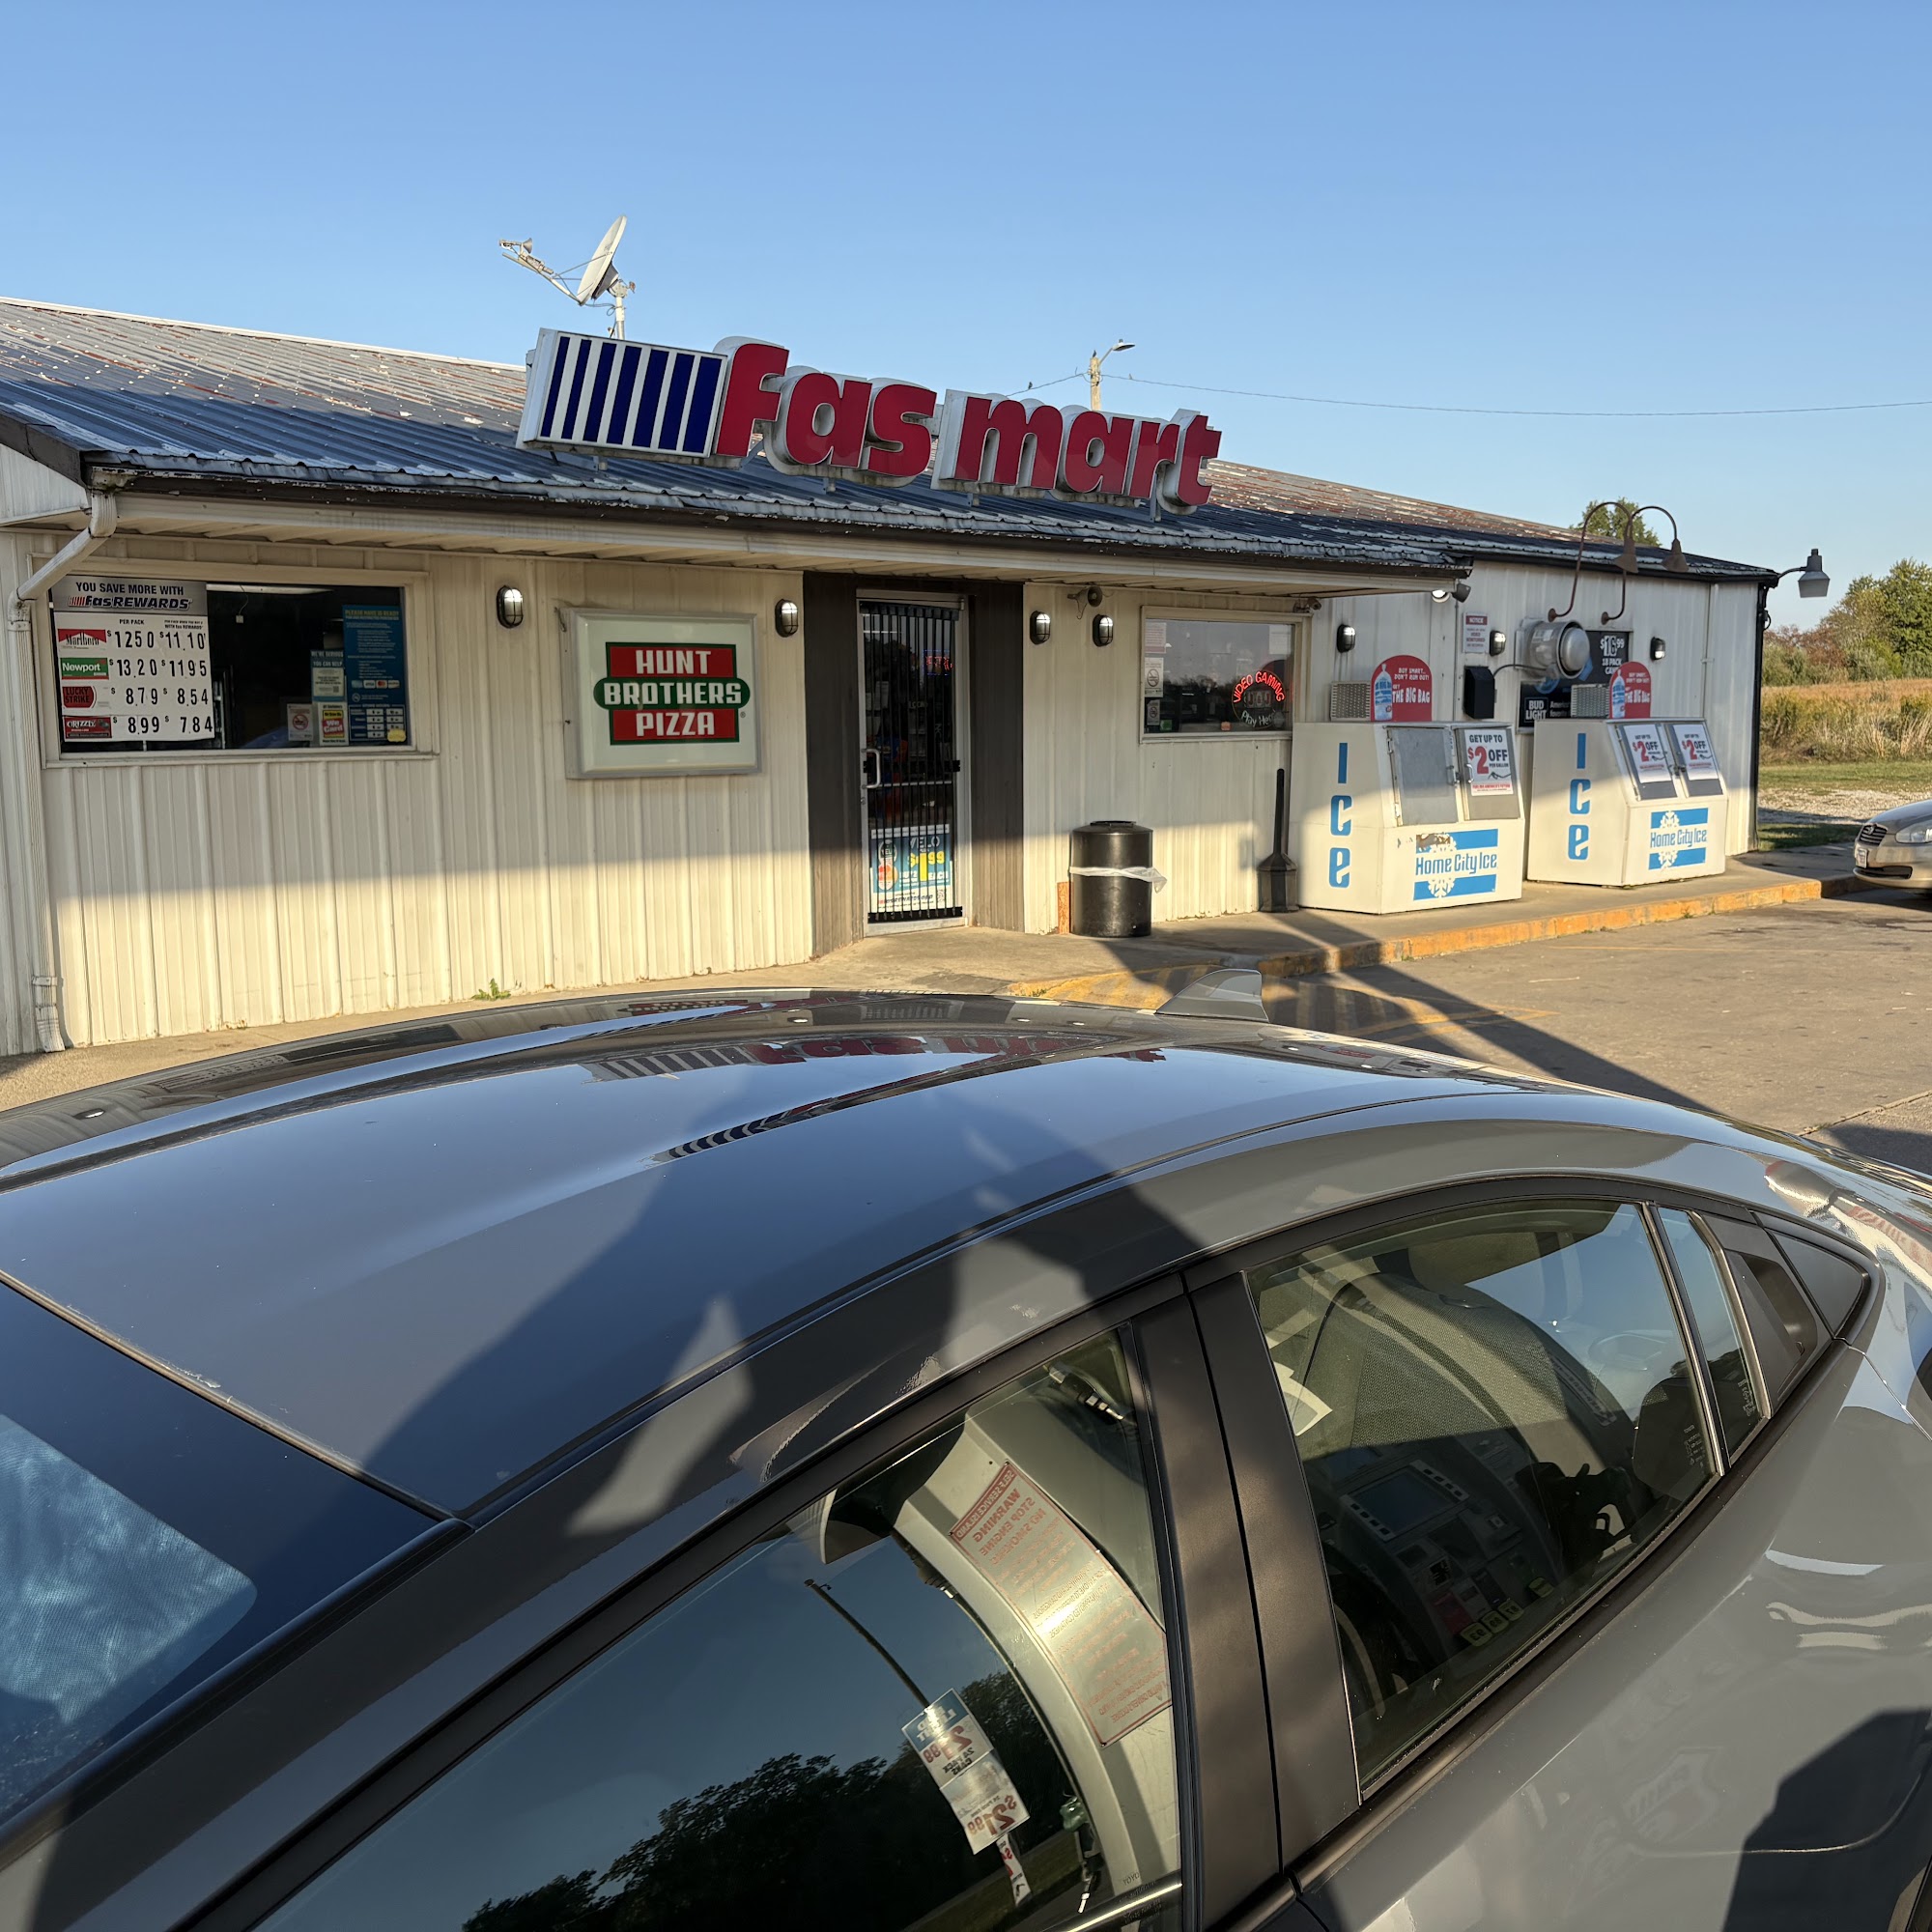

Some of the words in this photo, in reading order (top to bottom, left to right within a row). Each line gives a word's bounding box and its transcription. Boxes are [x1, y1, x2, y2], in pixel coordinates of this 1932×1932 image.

[955, 397, 1222, 506] mart
[76, 582, 97, 592] YOU
[99, 583, 126, 593] SAVE
[128, 584, 156, 594] MORE
[159, 585, 184, 596] WITH
[66, 632, 99, 646] Marlboro
[62, 662, 101, 673] Newport
[636, 650, 711, 674] HUNT
[604, 682, 741, 704] BROTHERS
[1234, 674, 1253, 703] VIDEO
[1256, 671, 1285, 701] GAMING
[1392, 689, 1404, 703] THE
[1406, 687, 1416, 703] BIG
[1417, 689, 1430, 703] BAG
[1528, 700, 1545, 710] BUD
[1241, 710, 1257, 727] Play
[1525, 710, 1548, 721] LIGHT
[637, 712, 714, 736] PIZZA
[1469, 734, 1482, 743] GET
[1493, 734, 1502, 743] TO
[1694, 741, 1706, 750] OFF
[1645, 742, 1658, 751] OFF
[1488, 749, 1508, 761] OFF
[1650, 832, 1676, 848] Home
[1677, 829, 1693, 847] City
[1693, 827, 1707, 842] Ice
[1415, 854, 1452, 876] Home
[1454, 854, 1478, 878] City
[1479, 852, 1497, 869] Ice
